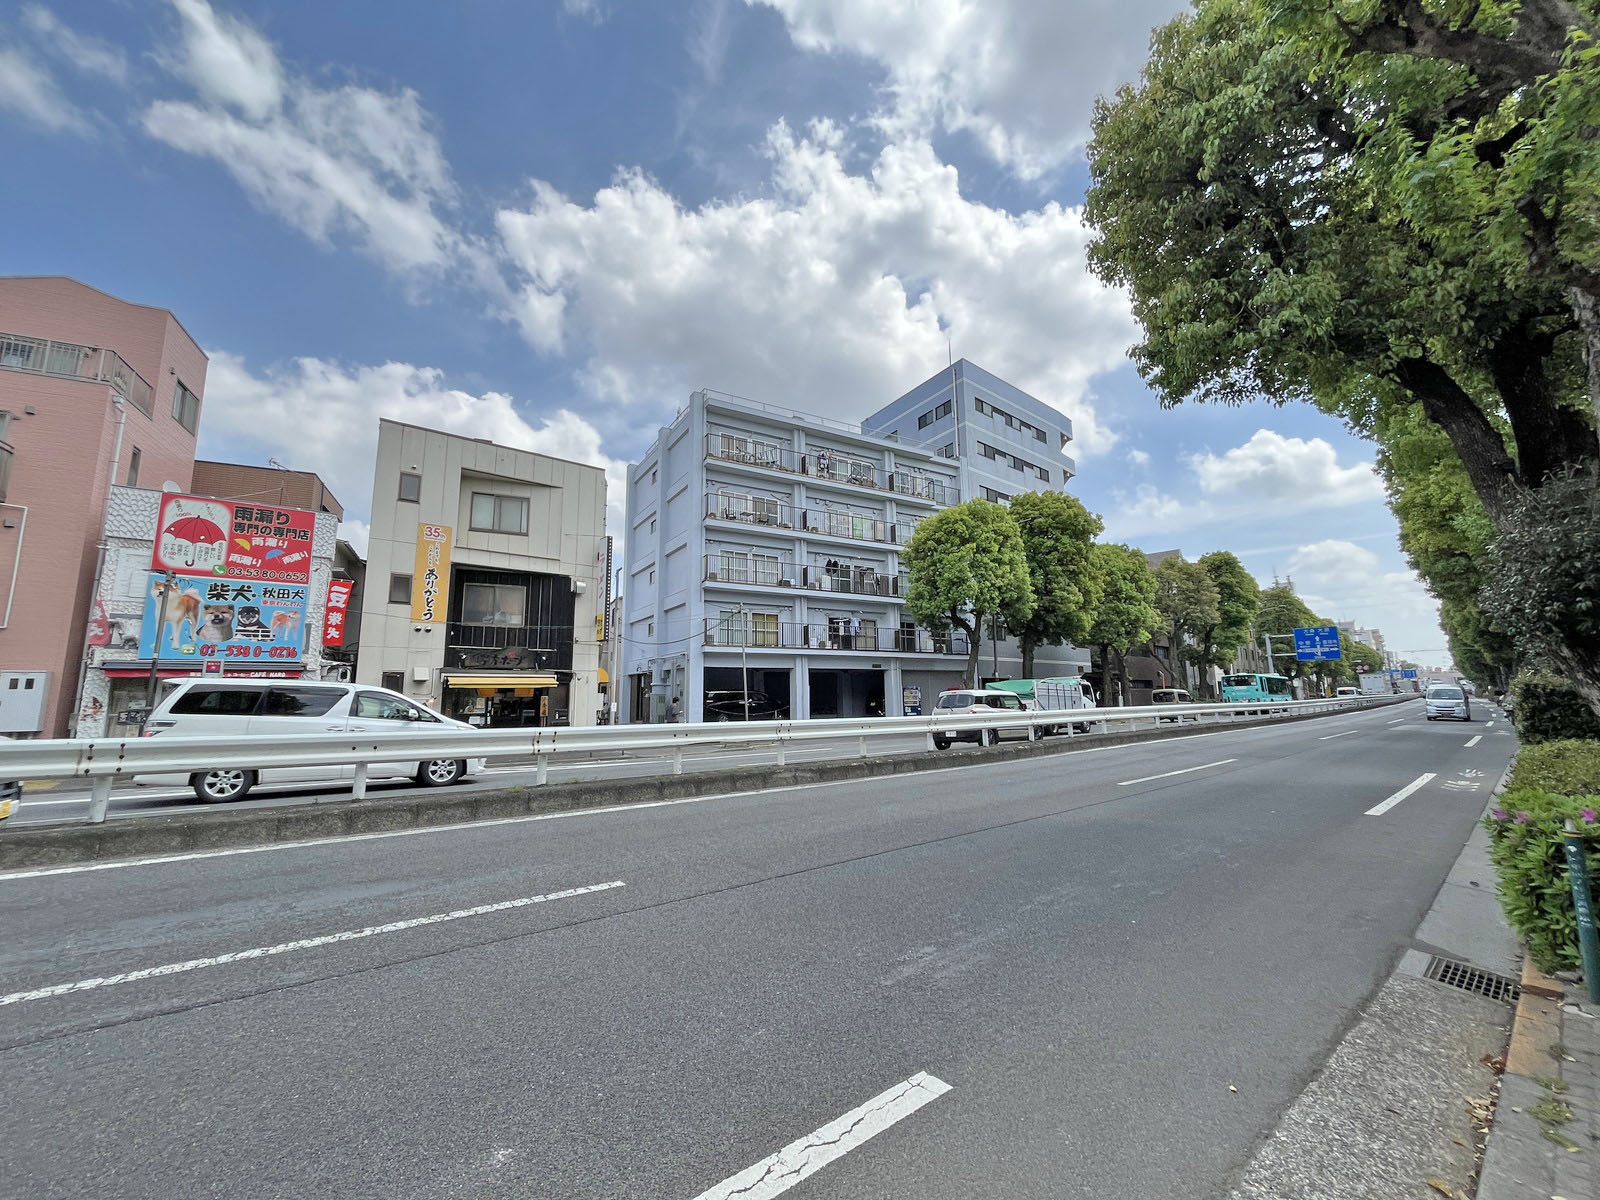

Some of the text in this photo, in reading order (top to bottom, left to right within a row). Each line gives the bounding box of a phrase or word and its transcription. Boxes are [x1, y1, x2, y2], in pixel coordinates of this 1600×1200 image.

[234, 506, 290, 525] 雨漏り
[233, 523, 310, 540] 専門の専門店
[252, 537, 288, 549] 雨漏り
[262, 587, 305, 600] 秋田犬
[423, 568, 438, 621] ありがとう
